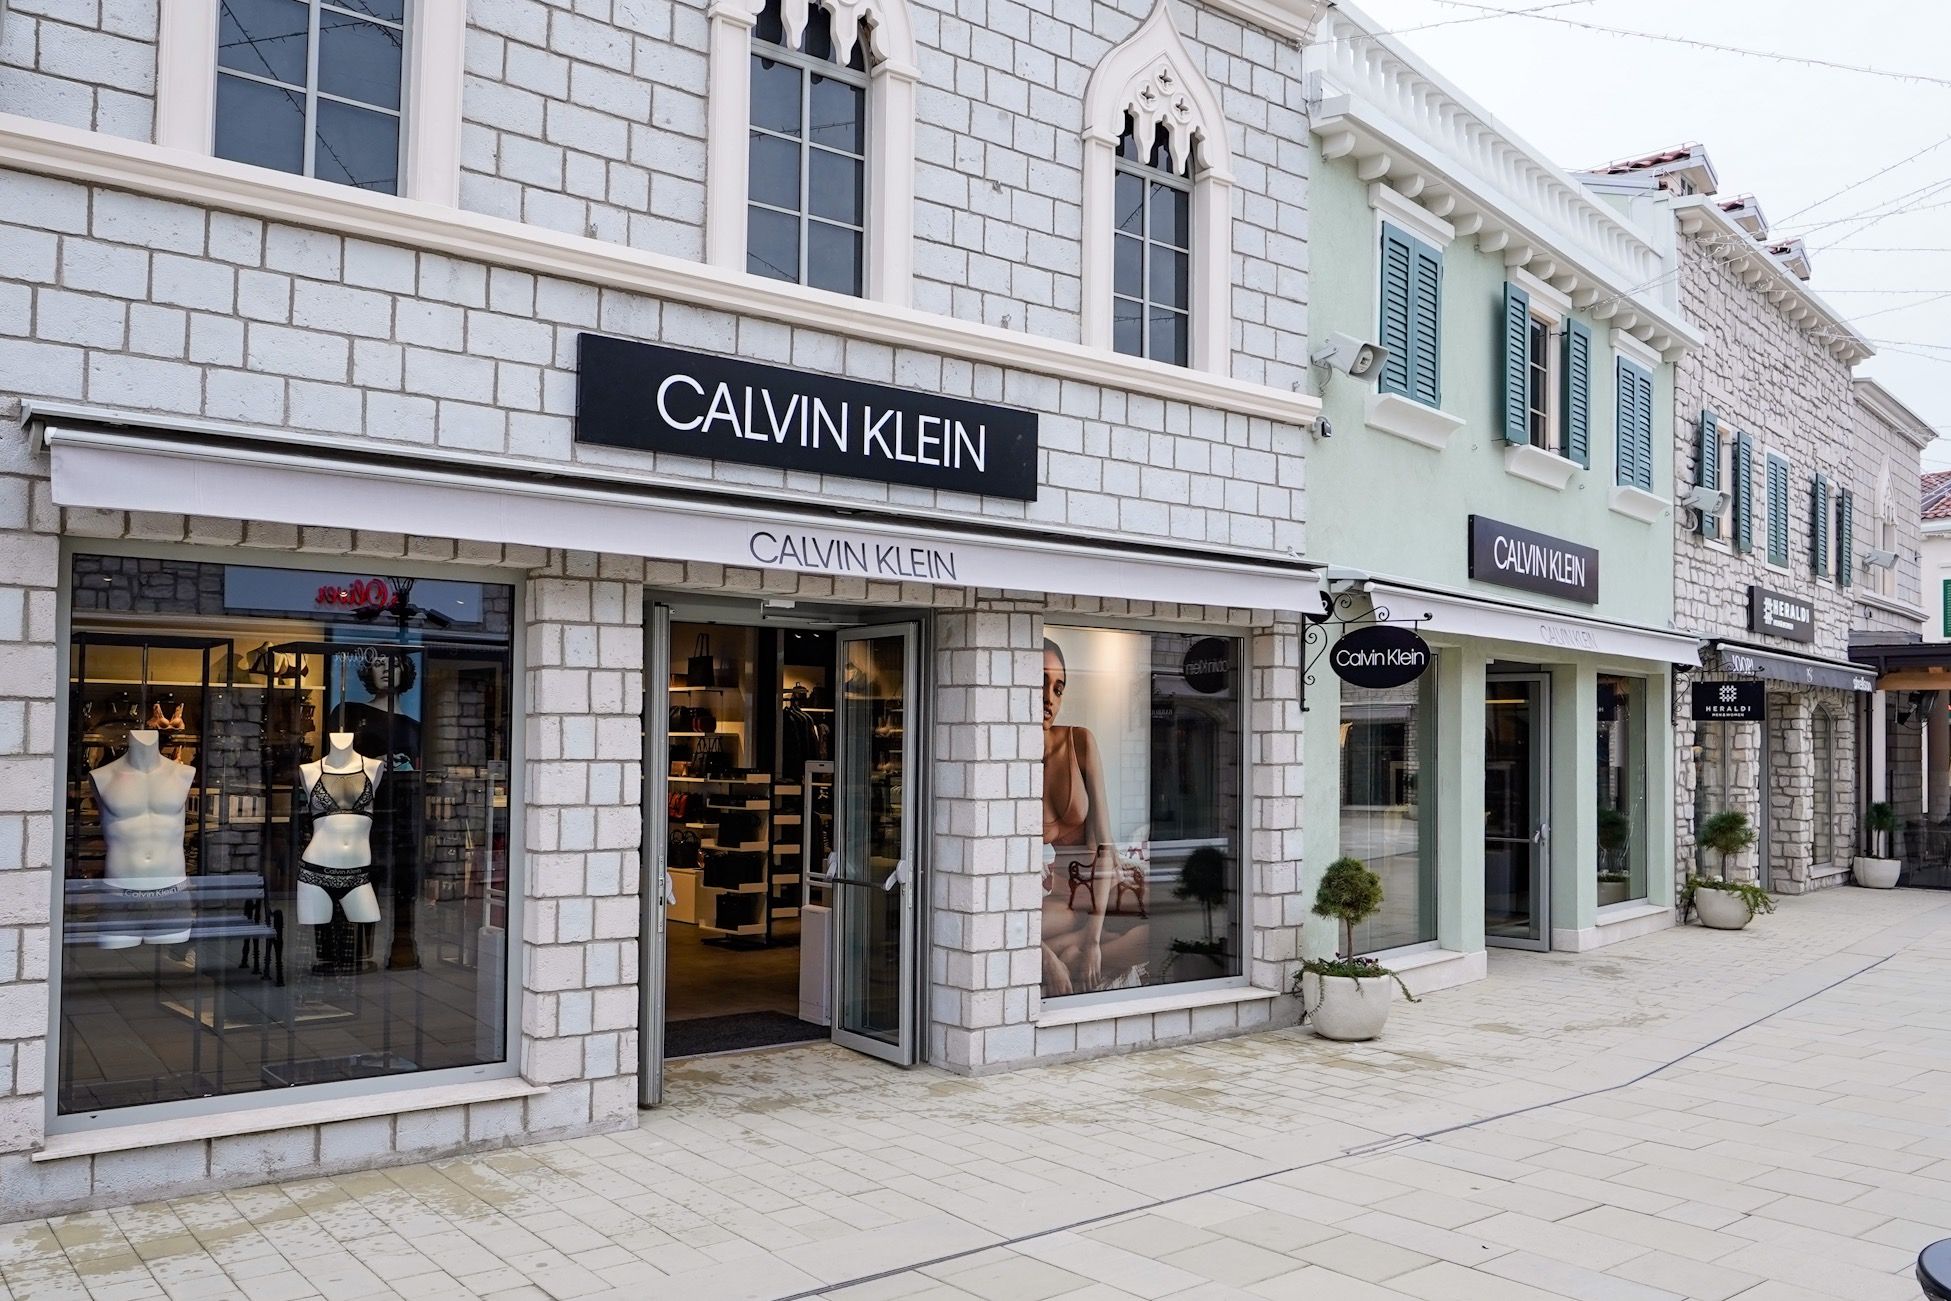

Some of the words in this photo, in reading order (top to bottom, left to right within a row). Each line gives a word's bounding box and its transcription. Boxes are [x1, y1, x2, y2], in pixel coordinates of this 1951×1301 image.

[656, 374, 848, 452] CALVIN
[863, 405, 985, 473] KLEIN
[749, 531, 868, 572] CALVIN
[876, 544, 957, 581] KLEIN
[1493, 535, 1547, 578] CALVIN
[1550, 548, 1585, 588] KLEIN
[1772, 599, 1810, 624] HERALDI
[1336, 649, 1385, 666] Calvin
[1387, 648, 1425, 666] Klein
[124, 889, 155, 899] Calvin
[156, 886, 177, 897] Klein
